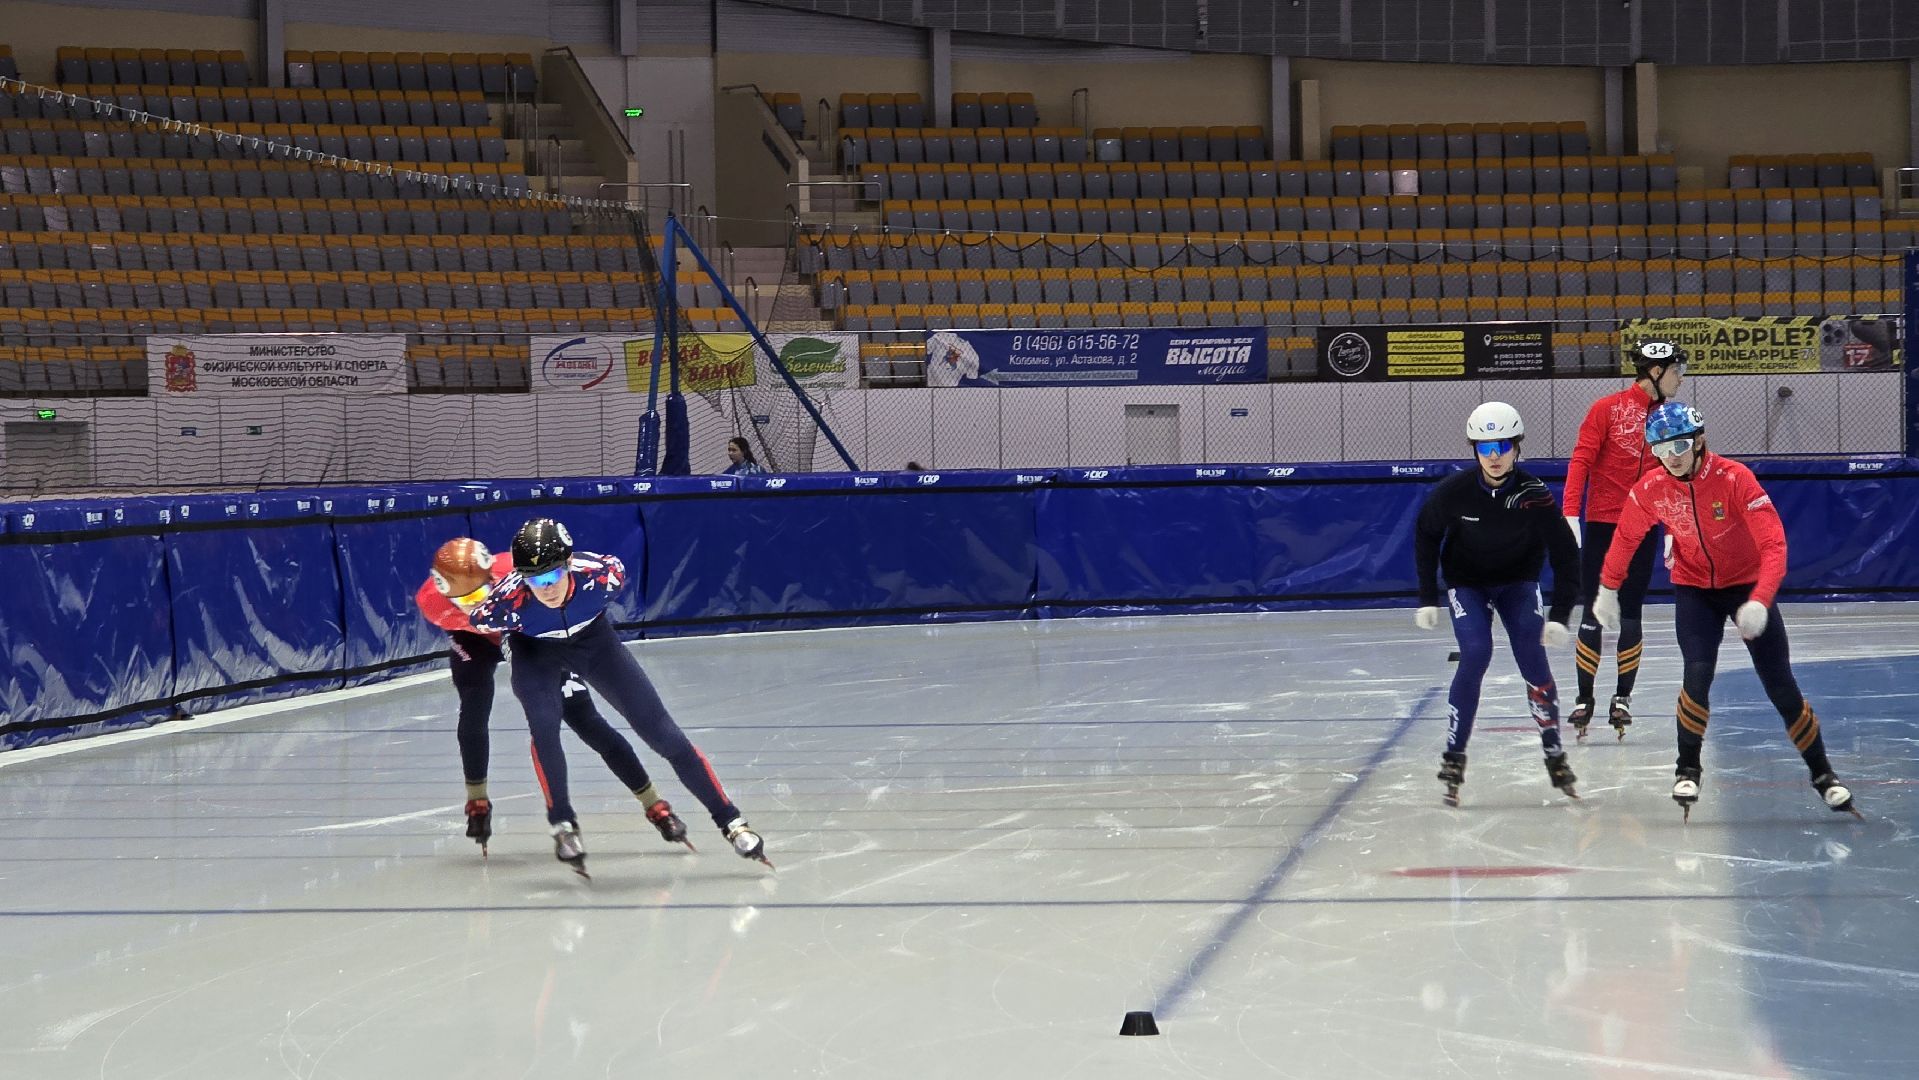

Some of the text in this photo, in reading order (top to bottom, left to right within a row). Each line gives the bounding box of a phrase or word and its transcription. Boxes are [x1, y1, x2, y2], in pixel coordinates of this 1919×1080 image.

[1649, 322, 1710, 330] ГДЕ КУПИТЬ
[1013, 333, 1140, 350] 8 (496) 615-56-72
[1712, 326, 1815, 347] APPLE?
[250, 346, 336, 357] МИНИСТЕРСТВО
[1165, 345, 1252, 365] ВЫСОТА
[1650, 345, 1668, 355] 34
[1695, 350, 1705, 361] В
[1710, 349, 1799, 360] PINEAPPLE
[1130, 352, 1137, 364] 2
[1846, 349, 1870, 366] 17
[203, 360, 387, 373] ФИЗИЧЕСКОЙ КУЛЬТУРЫ И СПОРТА
[1197, 365, 1247, 382] медиа
[232, 375, 358, 388] МОСКОВСКОЙ ОБЛАСТИ
[1399, 467, 1425, 475] OLYMP
[1857, 462, 1884, 470] OLYMP
